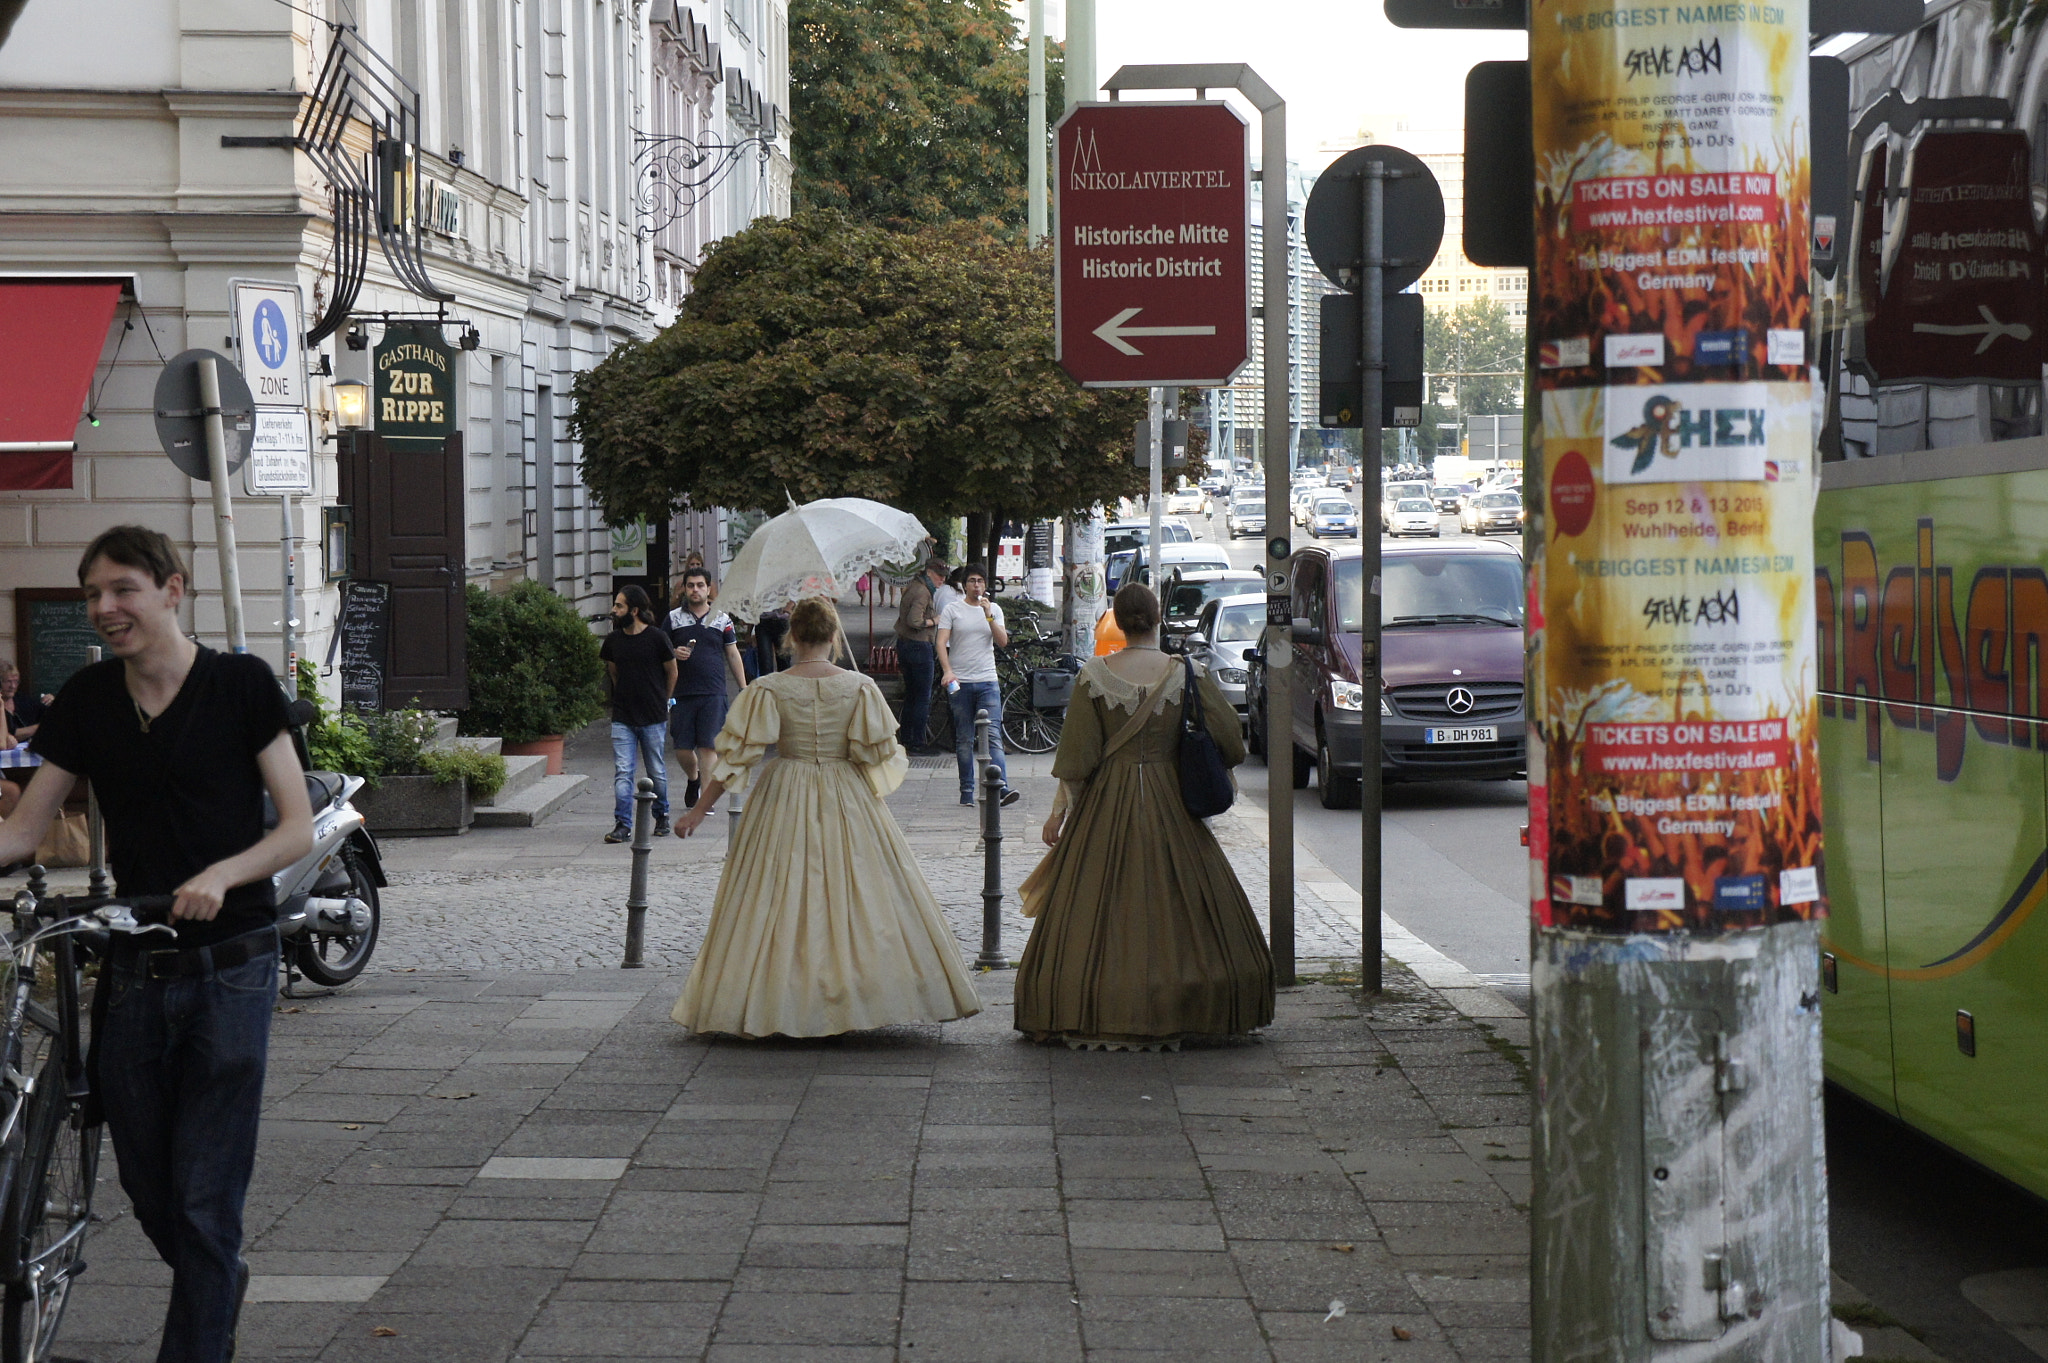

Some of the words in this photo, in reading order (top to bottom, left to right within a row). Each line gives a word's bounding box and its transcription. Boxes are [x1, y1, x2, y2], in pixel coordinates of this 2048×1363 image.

[1587, 7, 1670, 29] BIGGEST
[1677, 4, 1746, 25] NAMES
[1751, 5, 1760, 23] IN
[1764, 7, 1784, 25] EDM
[1624, 43, 1673, 82] STEVE
[1617, 96, 1650, 106] PHILIP
[1653, 94, 1698, 105] GEORGE
[1624, 109, 1638, 119] DE
[1664, 108, 1691, 119] MATT
[1695, 107, 1730, 118] DAREY
[1689, 121, 1719, 131] GANZ
[1679, 136, 1704, 148] 30+
[1707, 135, 1735, 148] DJ's
[1074, 170, 1231, 190] NIKOLAIVIERTEL
[1581, 178, 1649, 202] TICKETS
[1655, 179, 1685, 198] ON
[1690, 176, 1741, 197] SALE
[1746, 177, 1771, 195] NOW
[1589, 203, 1763, 227] www.hexfestival.com
[1075, 224, 1174, 246] Historische
[1179, 223, 1229, 244] Mitte
[1083, 257, 1152, 278] Historic
[1156, 257, 1221, 277] District
[1600, 251, 1662, 271] Biggest
[1667, 248, 1706, 266] EDM
[1638, 272, 1716, 291] Germany
[379, 344, 446, 372] GASTHAUS
[260, 376, 289, 395] ZONE
[390, 370, 433, 394] ZUR
[381, 397, 444, 423] RIPPE
[1626, 500, 1659, 516] Sep
[1666, 499, 1684, 514] 12
[1690, 499, 1703, 514] &
[1711, 498, 1729, 513] 13
[1623, 522, 1720, 538] Wuhlheide,
[1600, 558, 1687, 577] BIGGEST
[1695, 556, 1761, 575] NAMES
[1643, 595, 1692, 630] STEVE
[1726, 683, 1752, 697] DJ's
[1437, 730, 1445, 741] B
[1453, 729, 1469, 741] DH
[1471, 729, 1493, 740] 981
[1593, 726, 1668, 745] TICKETS
[1674, 725, 1704, 744] ON
[1709, 724, 1758, 743] SALE
[1759, 722, 1782, 741] NOW
[1602, 750, 1776, 771] www.hexfestival.com
[1616, 795, 1681, 815] Biggest
[1686, 794, 1726, 812] EDM
[1657, 818, 1736, 837] Germany
